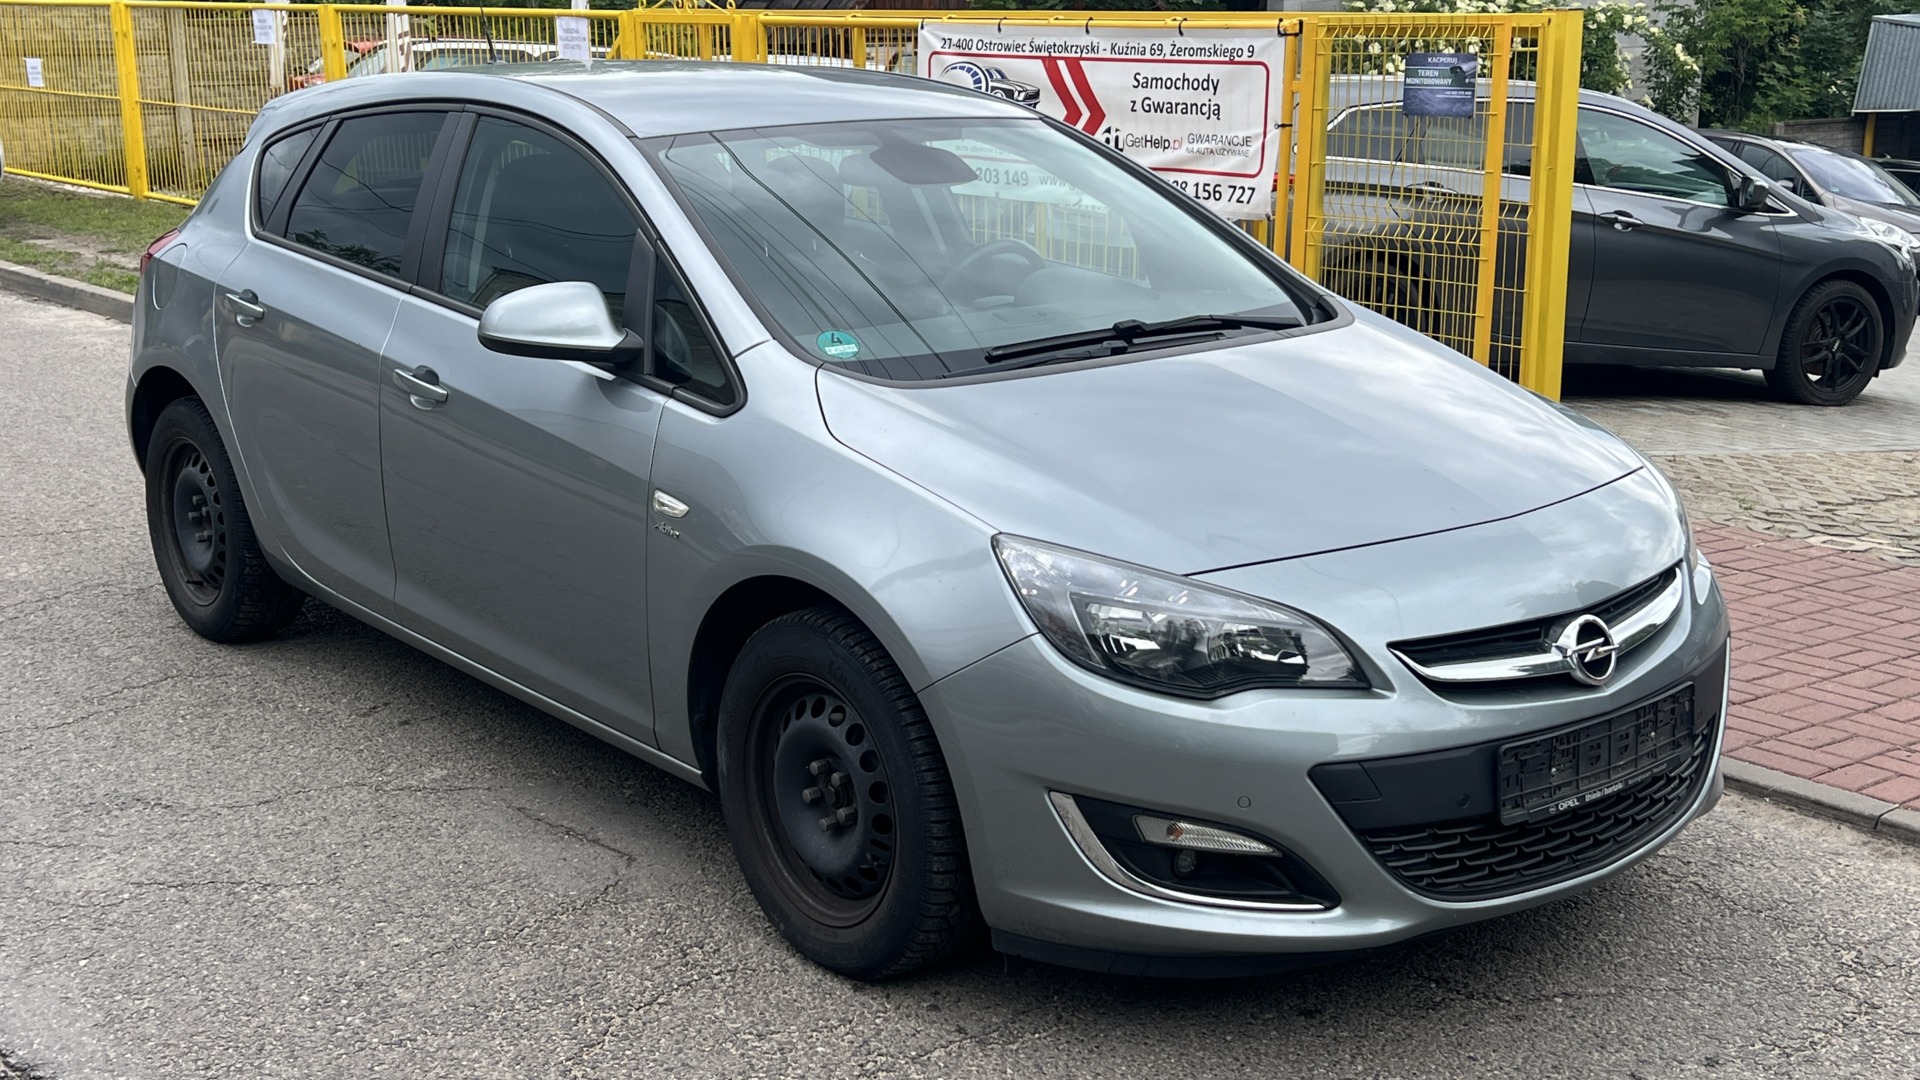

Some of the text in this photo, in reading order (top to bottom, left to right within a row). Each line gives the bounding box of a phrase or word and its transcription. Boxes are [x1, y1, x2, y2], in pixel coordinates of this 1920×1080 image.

[940, 37, 974, 51] 27-400
[976, 38, 1026, 53] Ostrowiec
[1028, 37, 1100, 58] Świętokrzyski
[1110, 41, 1147, 56] Kuźnia
[1149, 43, 1167, 59] 69,
[1169, 40, 1244, 61] Żeromskiego
[1247, 44, 1255, 58] 9
[1405, 77, 1453, 85] MONITOROWANY
[1418, 69, 1439, 77] TEREN
[1132, 71, 1220, 96] Samochody
[1130, 96, 1221, 121] z Gwarancją
[1125, 133, 1183, 153] GetHelp.pl
[1187, 132, 1252, 148] GWARANCJE
[1185, 146, 1195, 155] NA
[1195, 147, 1215, 156] AUTA
[1003, 169, 1029, 187] 149
[1193, 181, 1222, 201] 156
[1227, 185, 1256, 205] 727
[831, 332, 843, 345] 4
[1558, 797, 1580, 811] OPEL
